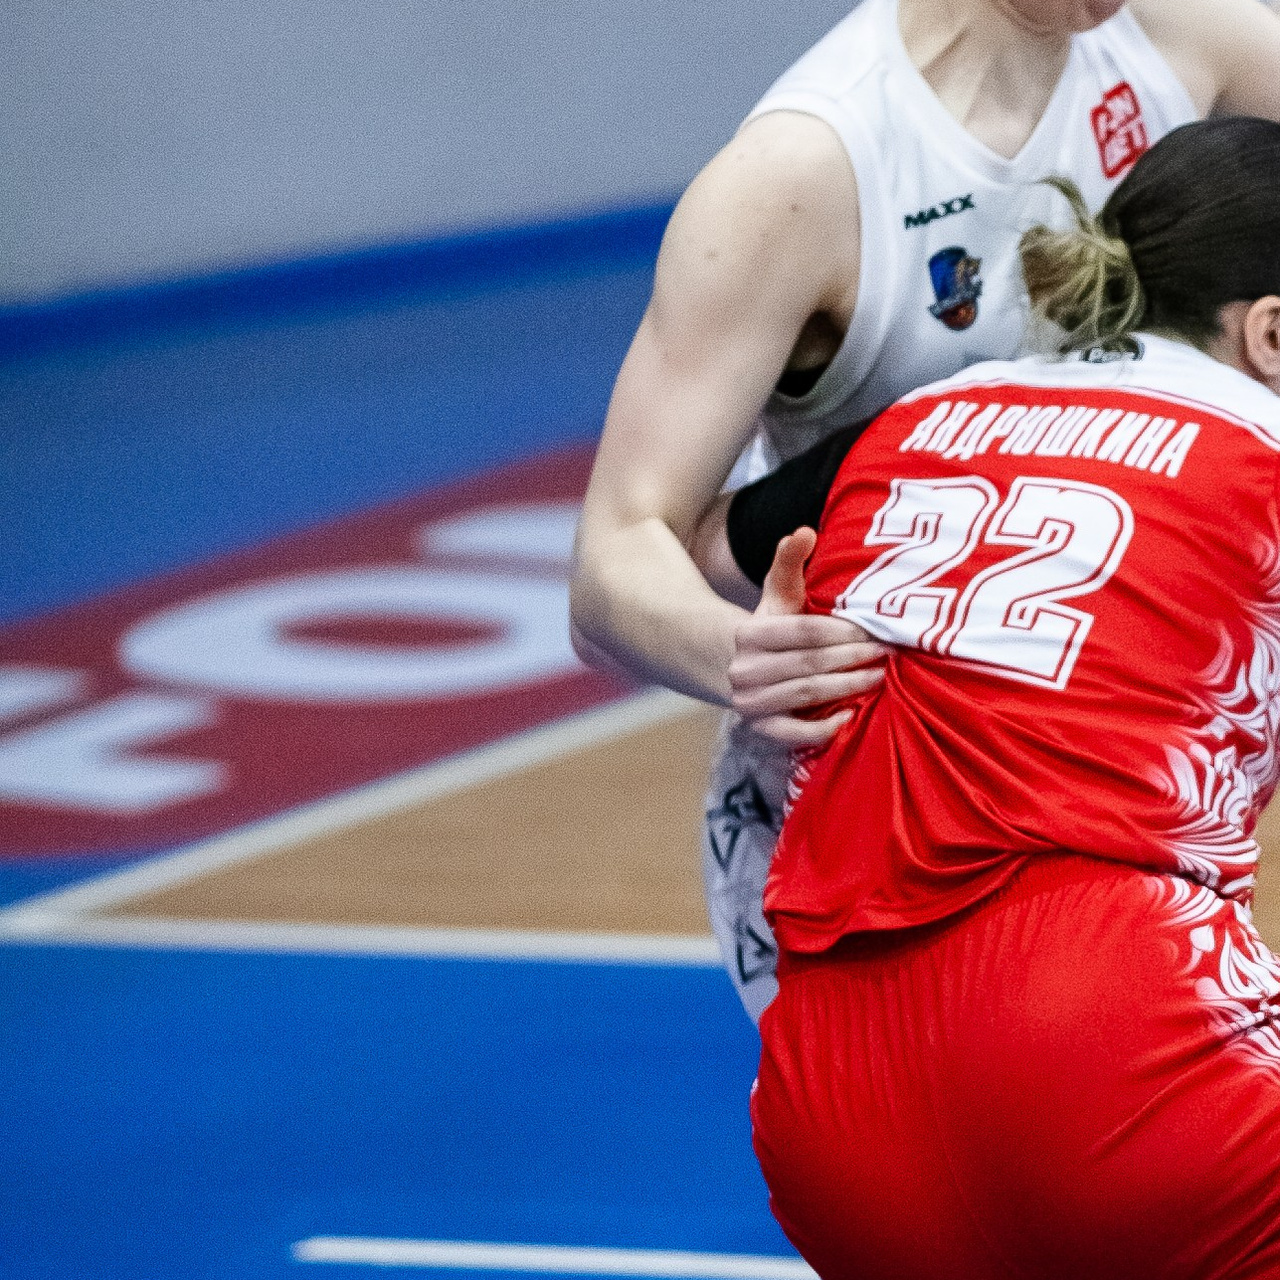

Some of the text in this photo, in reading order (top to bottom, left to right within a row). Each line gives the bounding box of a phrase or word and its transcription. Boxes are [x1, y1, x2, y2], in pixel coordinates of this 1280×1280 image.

[904, 192, 975, 230] MAXX
[900, 400, 1202, 480] АНДРЮШКИНА
[832, 475, 1135, 691] 22
